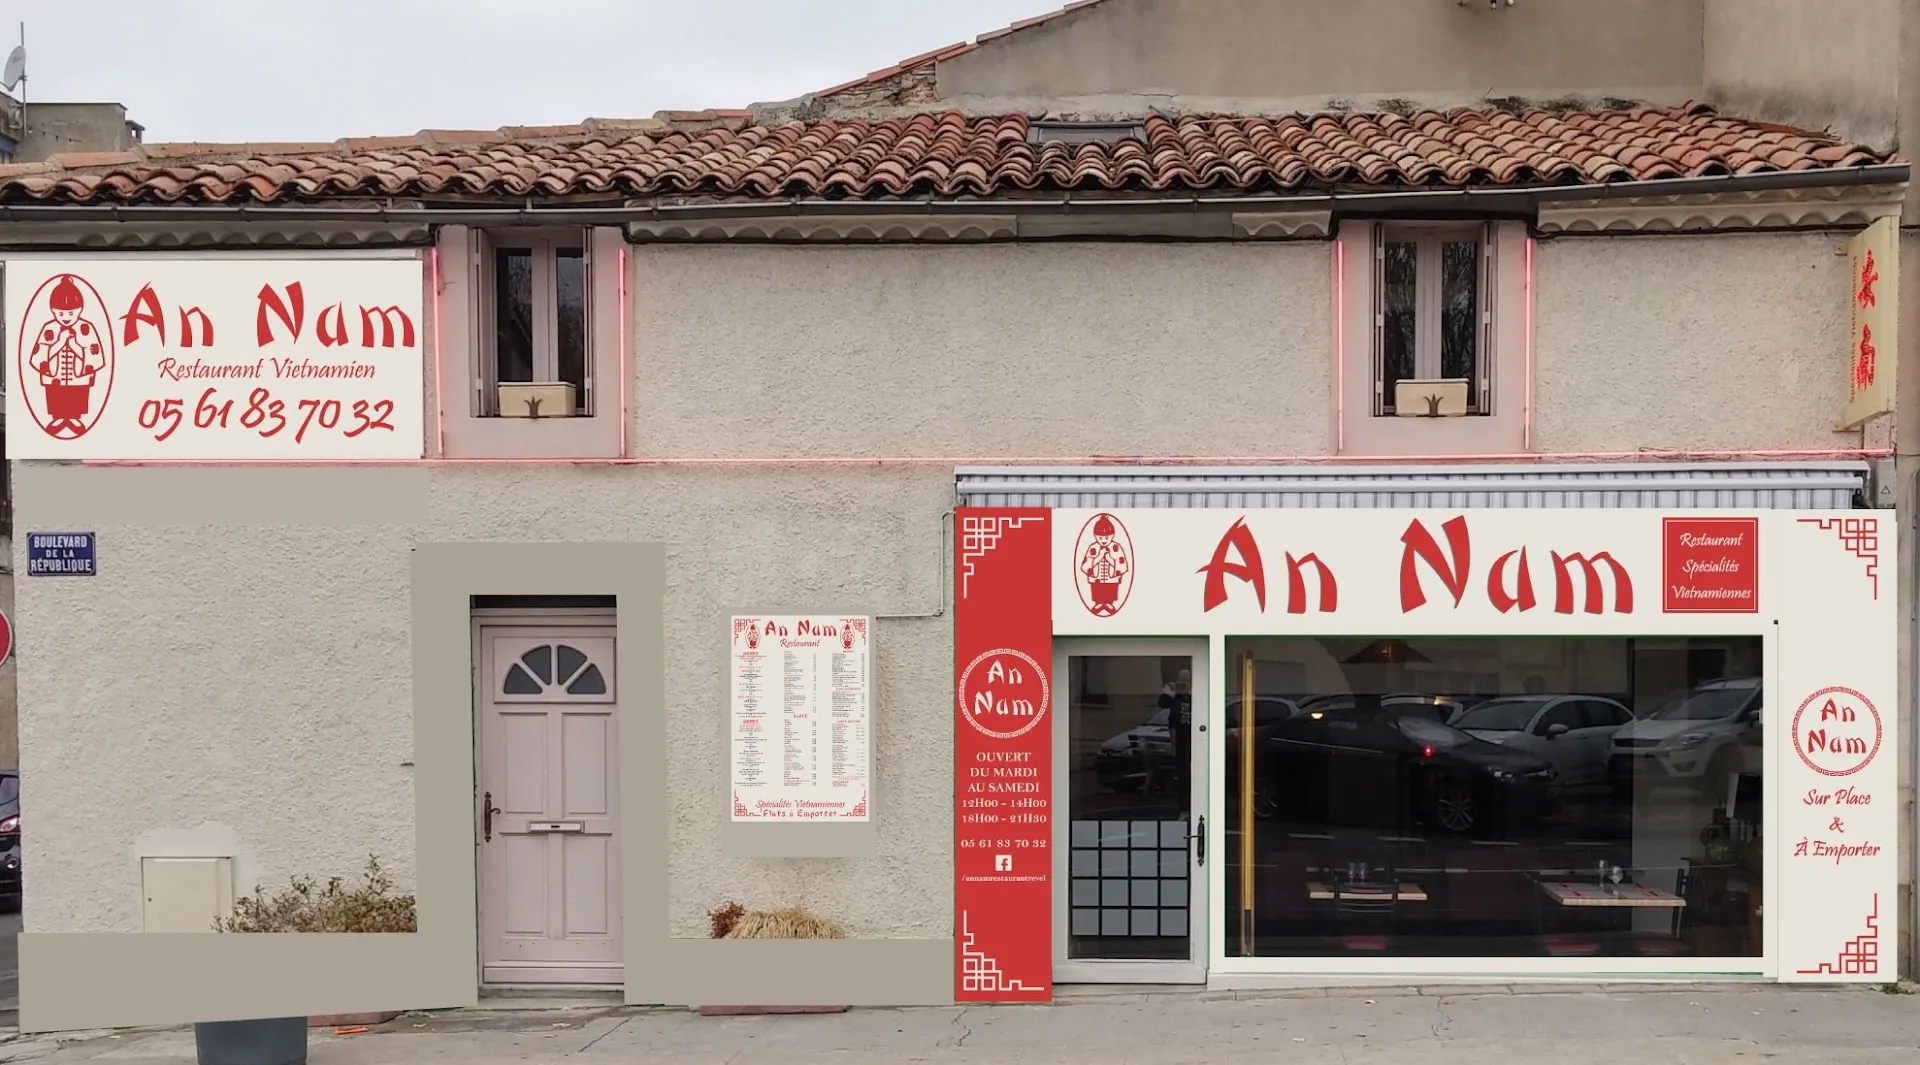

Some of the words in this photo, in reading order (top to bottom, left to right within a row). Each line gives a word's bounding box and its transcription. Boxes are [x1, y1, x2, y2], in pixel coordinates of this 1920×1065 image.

[119, 281, 213, 347] An
[257, 281, 414, 348] Nam
[158, 358, 264, 381] Restaurant
[270, 358, 374, 378] Vietnamien
[139, 399, 183, 441] 05
[194, 388, 234, 428] 61
[240, 388, 286, 437] 83
[295, 400, 340, 444] 70
[343, 400, 394, 437] 32
[34, 536, 87, 548] BOULEVARD
[1680, 533, 1743, 547] Restaurant
[46, 550, 57, 558] DE
[63, 550, 74, 558] LA
[30, 558, 92, 572] RÉPUBLIQUE
[1196, 516, 1337, 614] An
[1400, 515, 1633, 614] Nam
[1682, 557, 1739, 579] Spécialités
[1672, 586, 1751, 598] Vietnamiennes
[765, 621, 788, 636] An
[798, 620, 836, 636] Nam
[780, 639, 820, 648] Restaurant
[987, 659, 1025, 684] An
[974, 690, 1034, 717] Nam
[1821, 696, 1858, 722] An
[1808, 729, 1866, 753] Nam
[977, 752, 1031, 761] OUVERT
[971, 768, 989, 777] DU
[994, 768, 1037, 777] MARDI
[968, 783, 984, 792] AU
[989, 783, 1039, 792] SAMEDI
[963, 798, 998, 807] 12H00
[1012, 798, 1046, 807] 14H00
[1804, 789, 1830, 805] Sur
[1835, 786, 1871, 804] Place
[797, 810, 836, 819] Emporter
[963, 814, 998, 822] 18H00
[1010, 814, 1046, 823] 21H30
[1829, 817, 1844, 833] &
[961, 839, 974, 847] 05
[1794, 837, 1808, 856] À
[1813, 841, 1880, 865] Emporter
